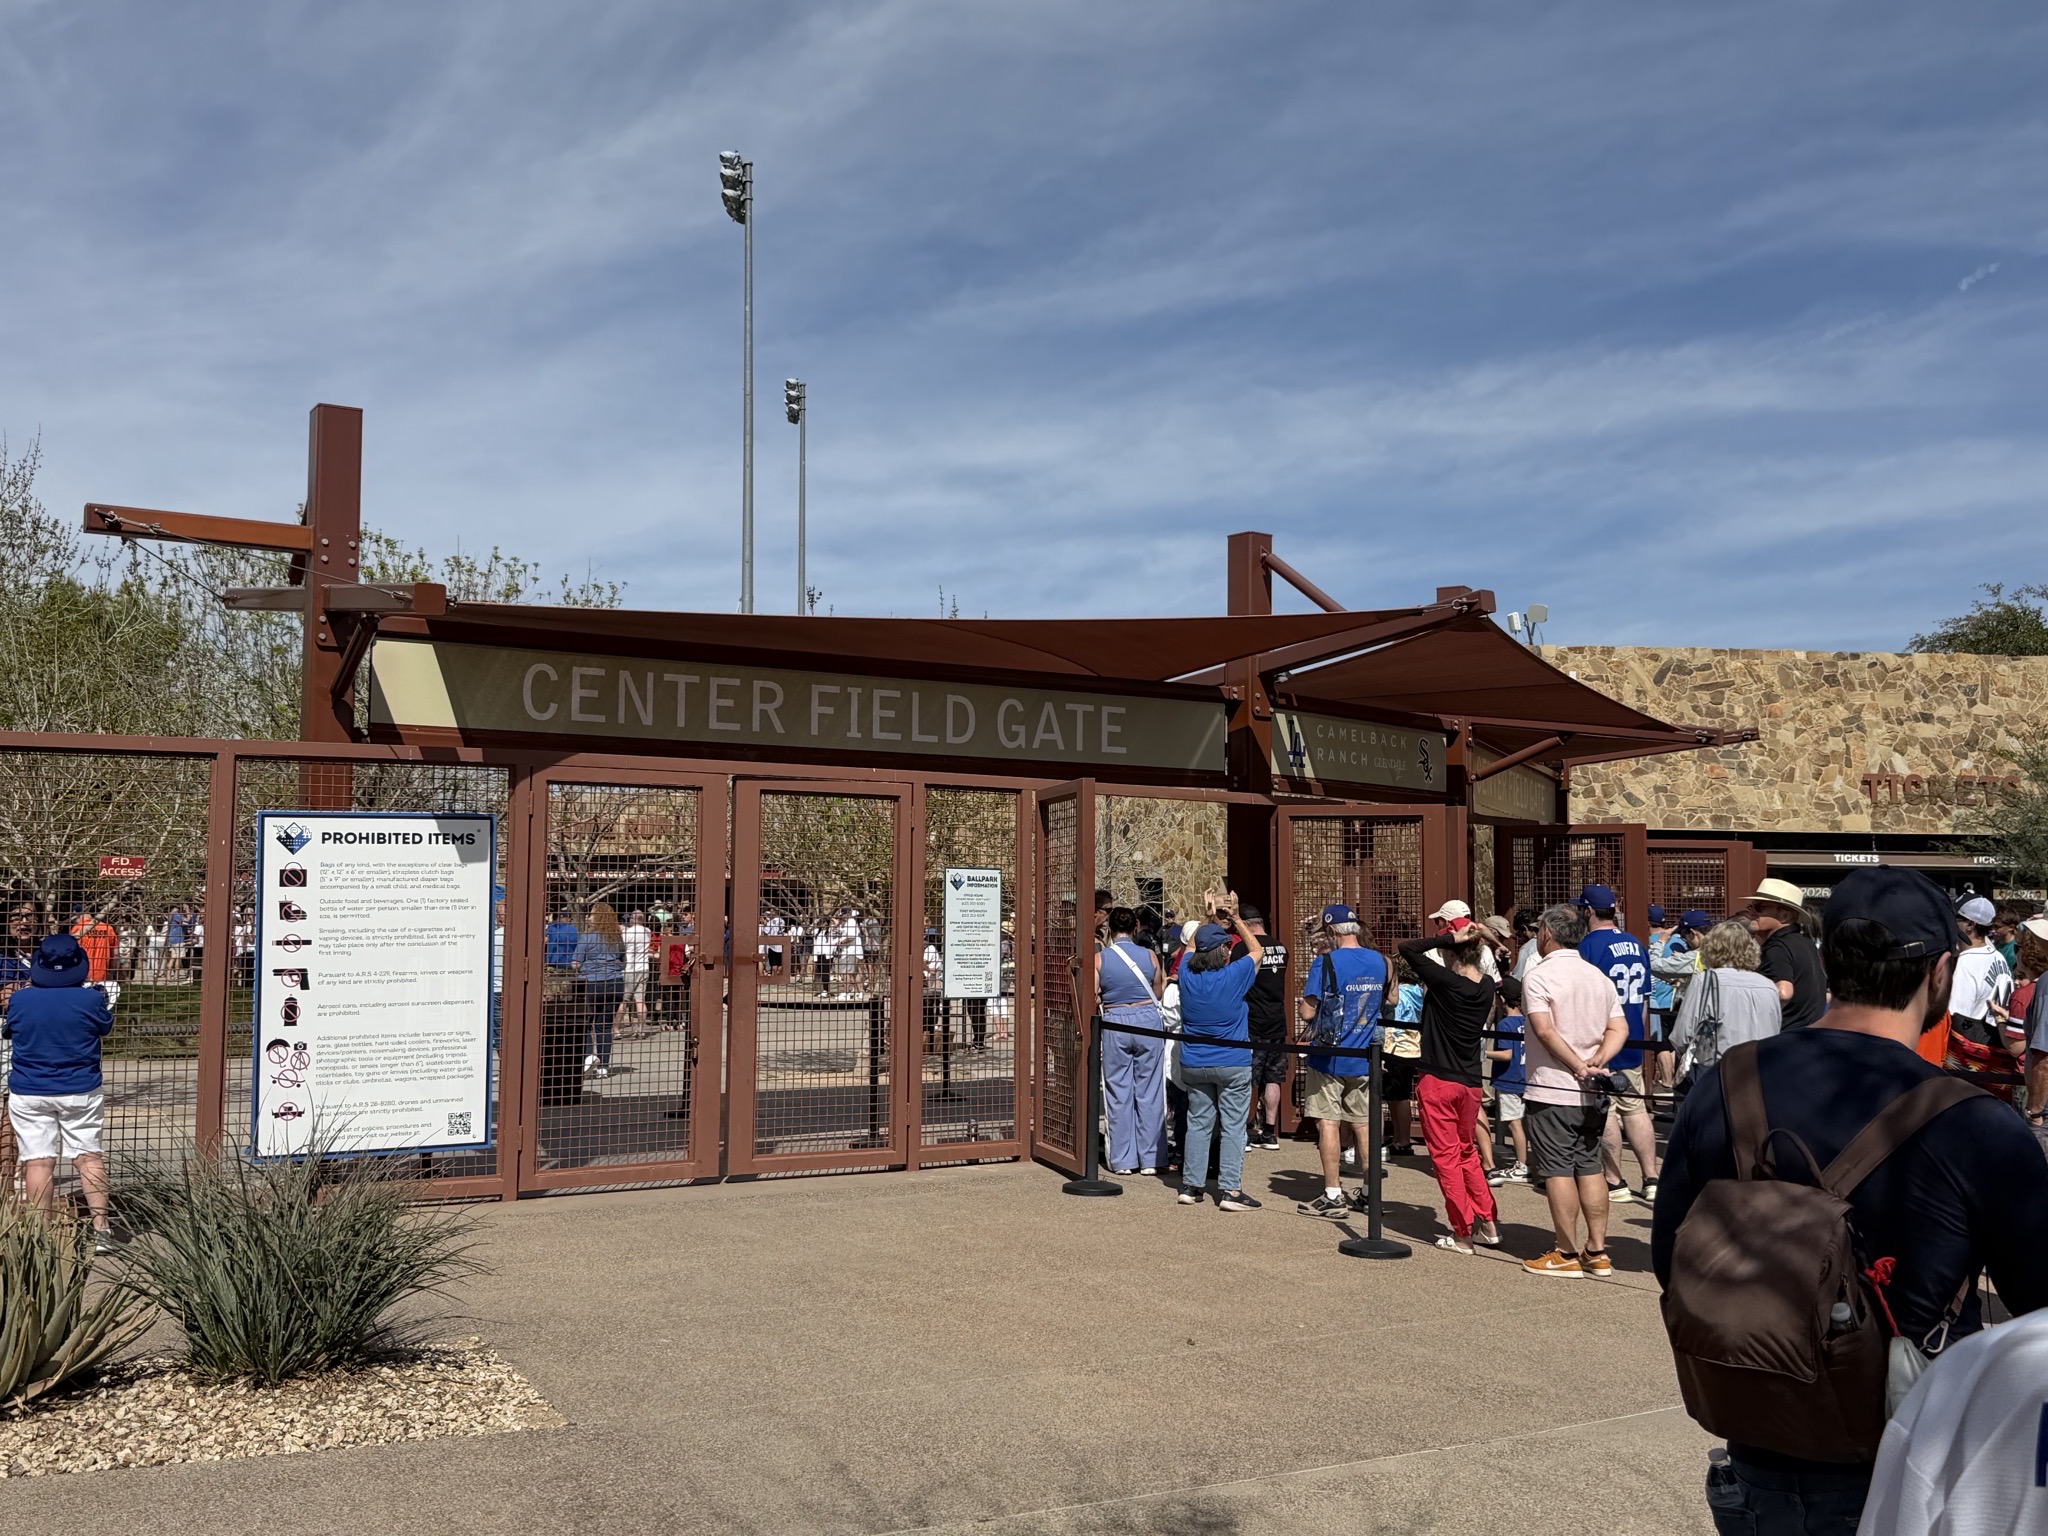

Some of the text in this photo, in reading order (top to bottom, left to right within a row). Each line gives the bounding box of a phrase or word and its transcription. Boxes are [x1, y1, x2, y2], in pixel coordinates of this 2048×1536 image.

[523, 663, 1126, 754] CENTER FIELD GATE
[1316, 724, 1407, 749] CAMELBACK
[1317, 748, 1368, 766] RANCH
[322, 832, 476, 845] PROHIBITED ITEMS
[111, 857, 132, 865] F.D.
[1834, 854, 1880, 862] TICKETS
[100, 868, 142, 876] ACCESS
[1608, 942, 1640, 958] KOUFAX
[1262, 954, 1284, 964] BACK
[1346, 984, 1382, 992] CHAMPIONS
[1609, 962, 1646, 1004] 32
